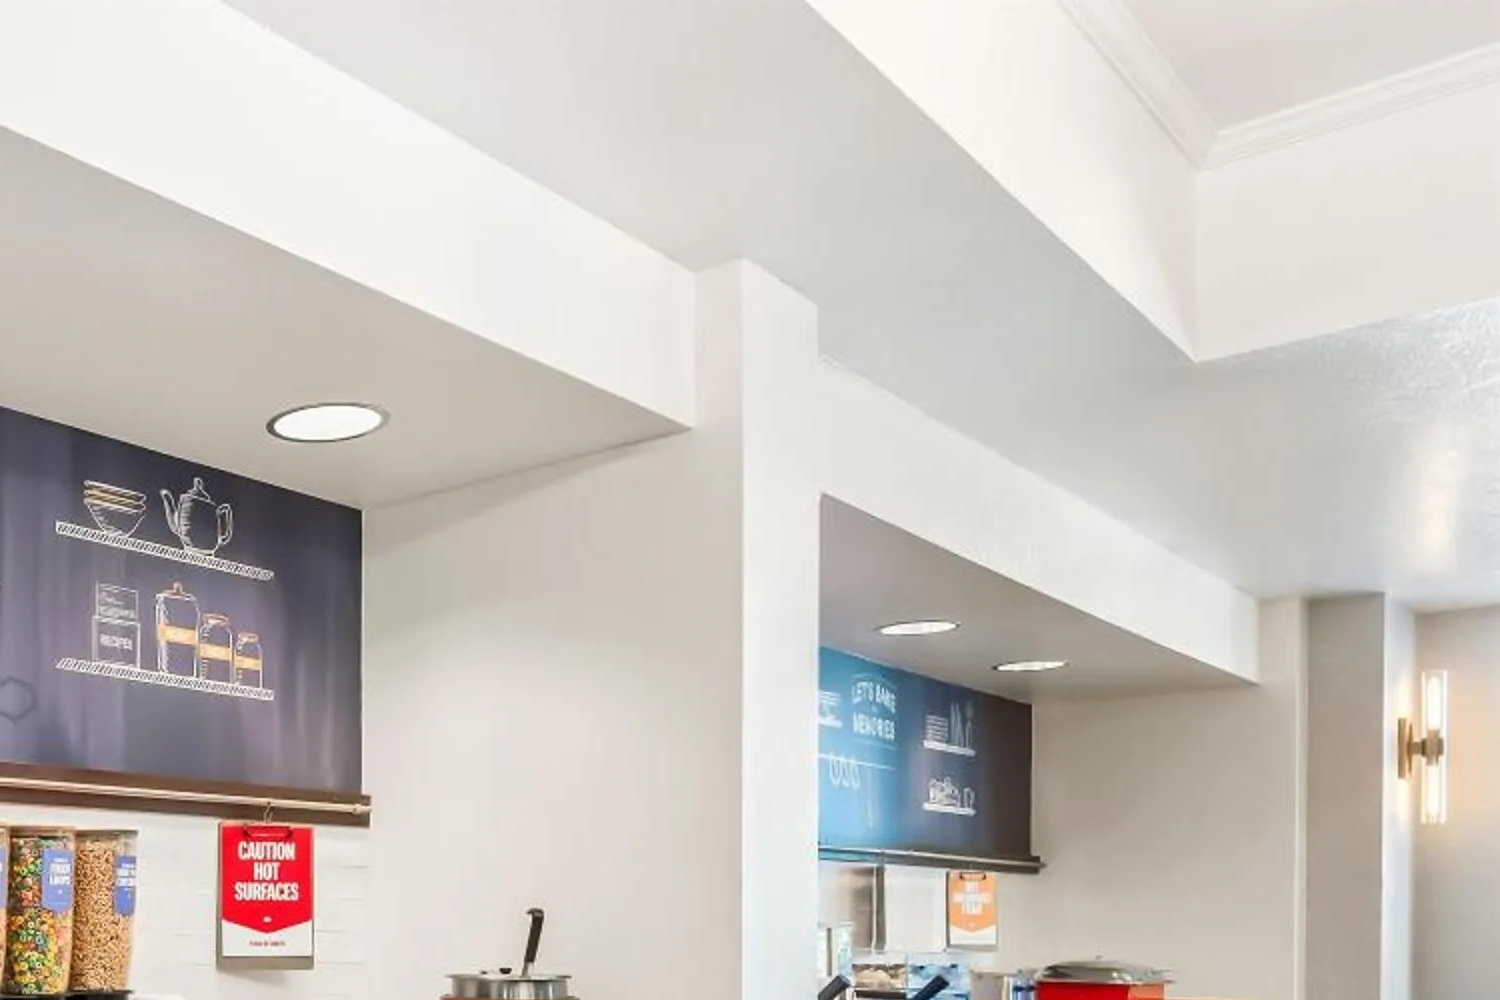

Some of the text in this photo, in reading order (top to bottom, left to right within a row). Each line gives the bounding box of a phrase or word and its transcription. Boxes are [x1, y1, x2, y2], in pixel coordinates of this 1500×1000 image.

[238, 841, 296, 860] CAUTION
[253, 861, 280, 880] HOT
[234, 881, 299, 901] SURFACES
